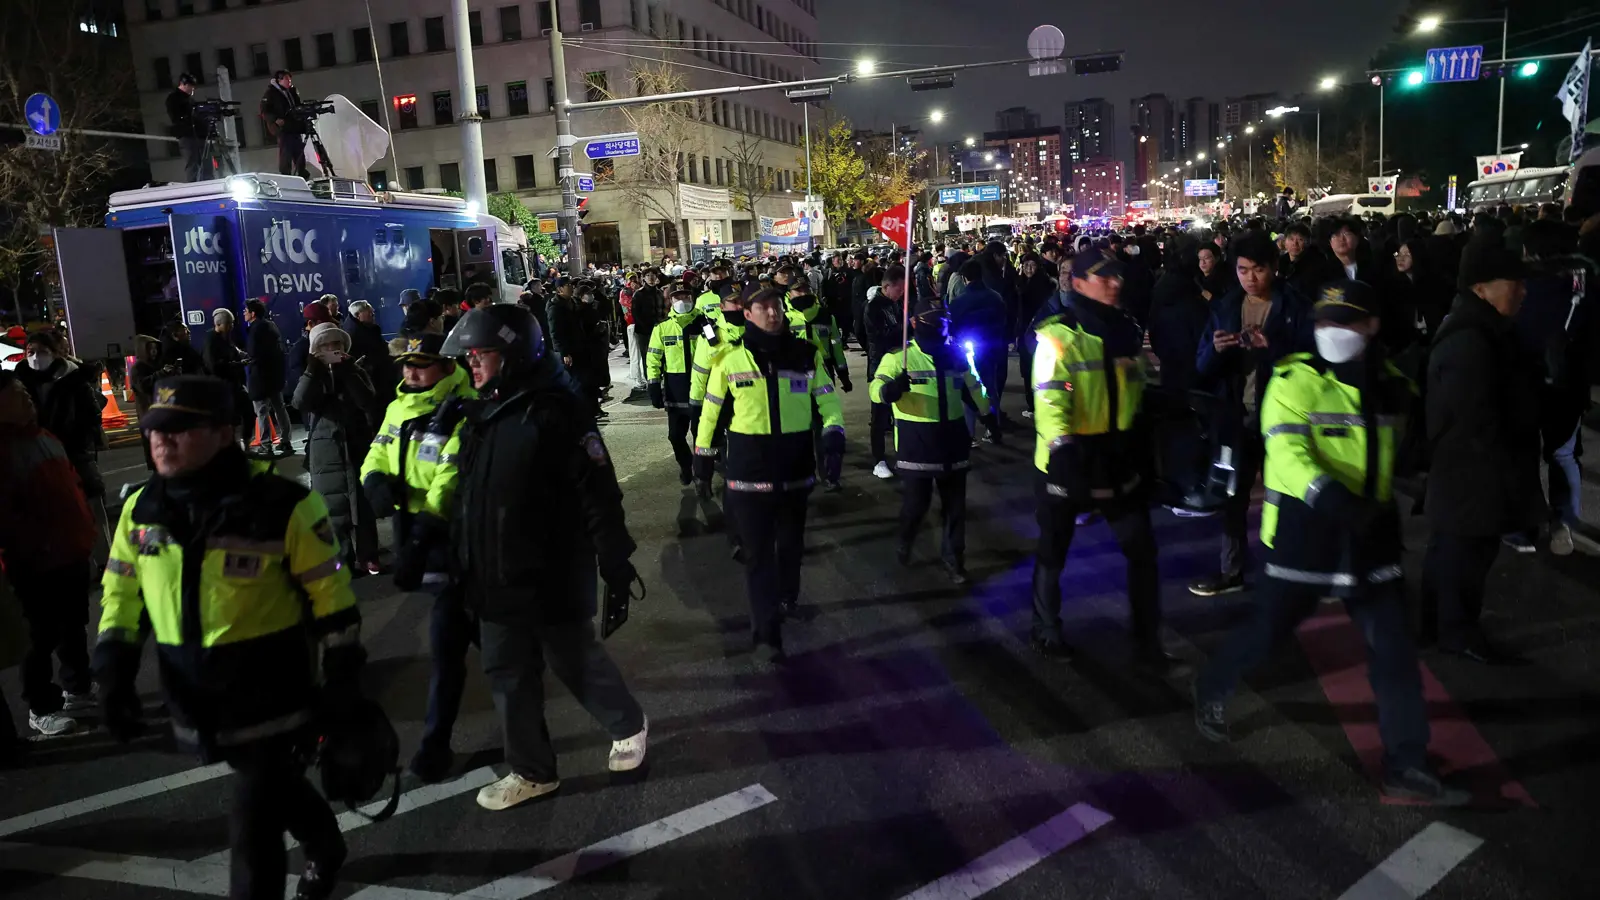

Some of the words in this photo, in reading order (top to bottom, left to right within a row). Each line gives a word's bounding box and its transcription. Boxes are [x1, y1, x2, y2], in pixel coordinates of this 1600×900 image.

[605, 140, 637, 150] 의사당대로
[183, 226, 223, 255] jtbc
[261, 220, 320, 264] jtbc
[185, 260, 227, 273] news
[263, 272, 324, 294] news
